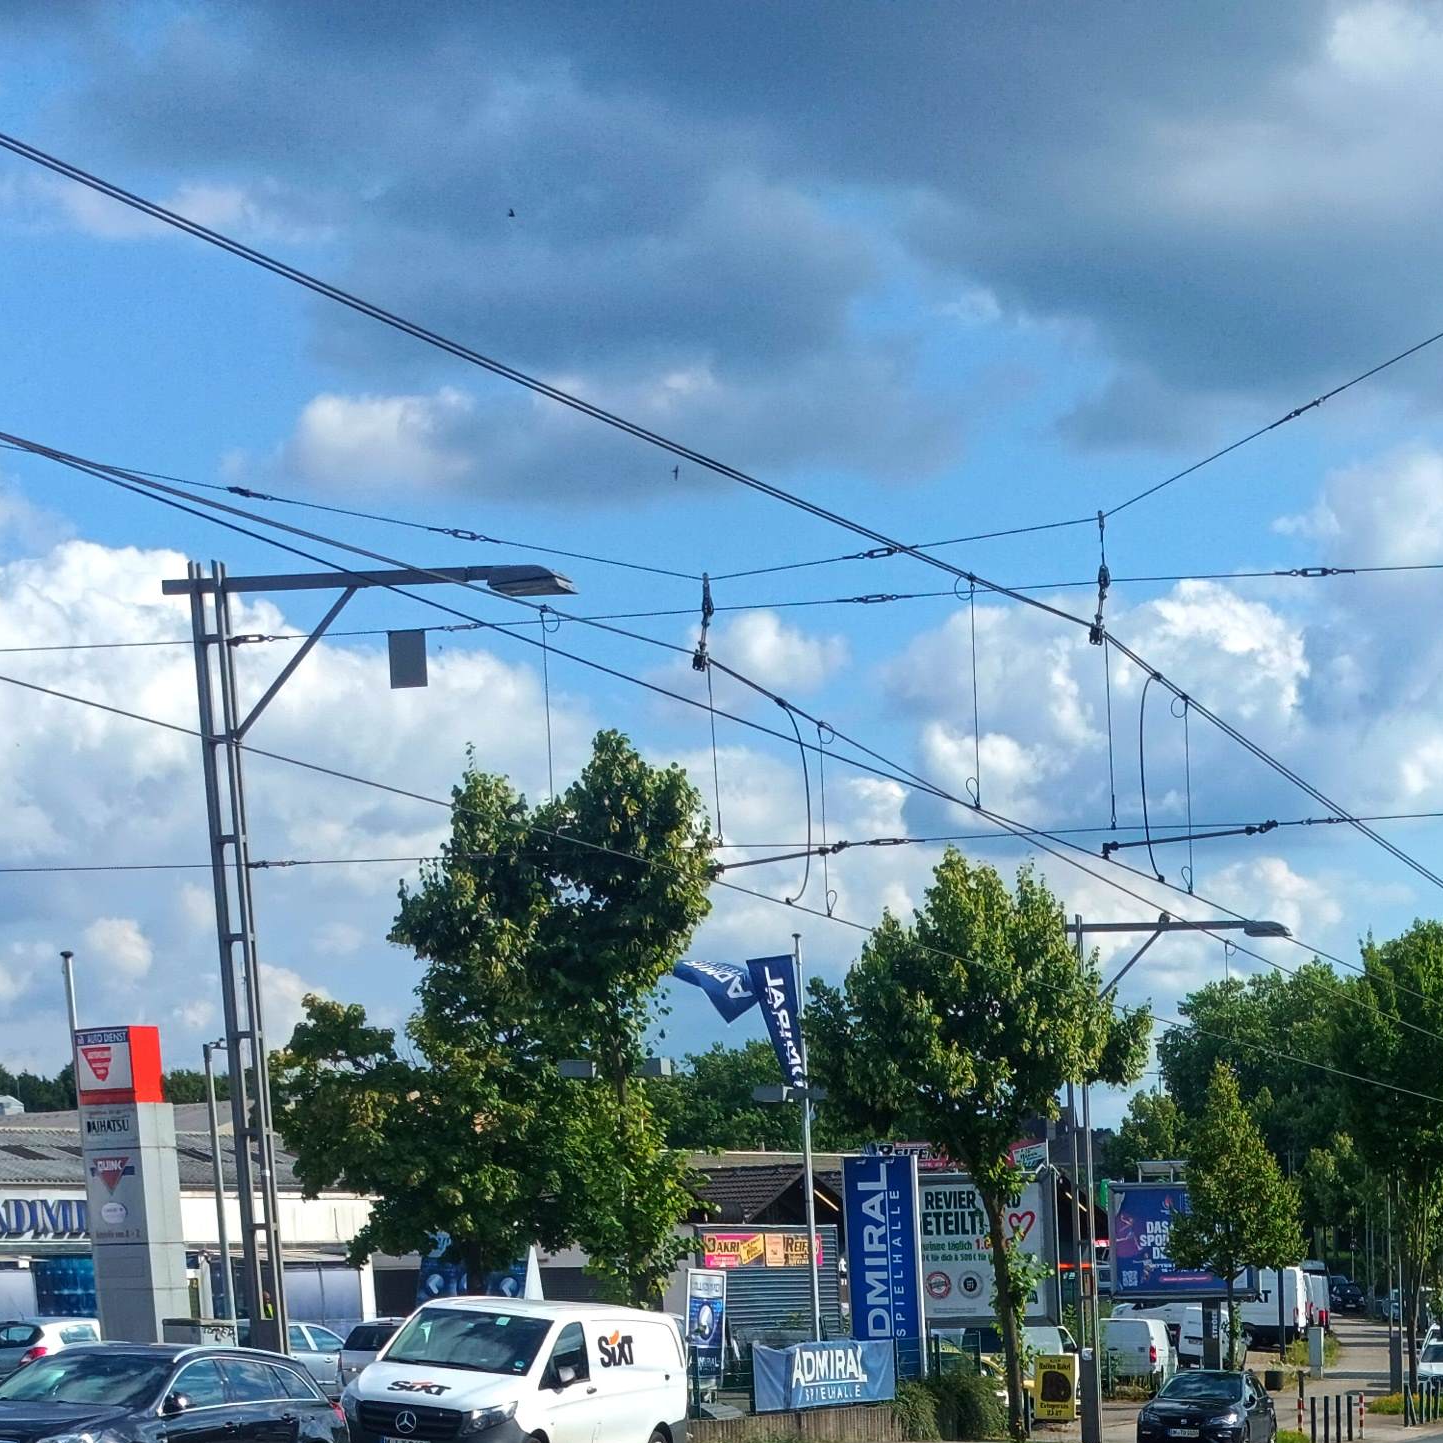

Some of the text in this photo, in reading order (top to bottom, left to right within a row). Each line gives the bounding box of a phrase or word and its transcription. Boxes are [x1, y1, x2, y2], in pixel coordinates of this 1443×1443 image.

[87, 1119, 129, 1134] DAIHATSU
[925, 1191, 977, 1210] REVIER
[921, 1211, 985, 1236] ETEILT!
[857, 1162, 891, 1338] DMIRAL
[889, 1190, 907, 1338] SPIELHALLE
[792, 1346, 868, 1388] ADMIRAL
[804, 1385, 862, 1401] SPIELHALLE
